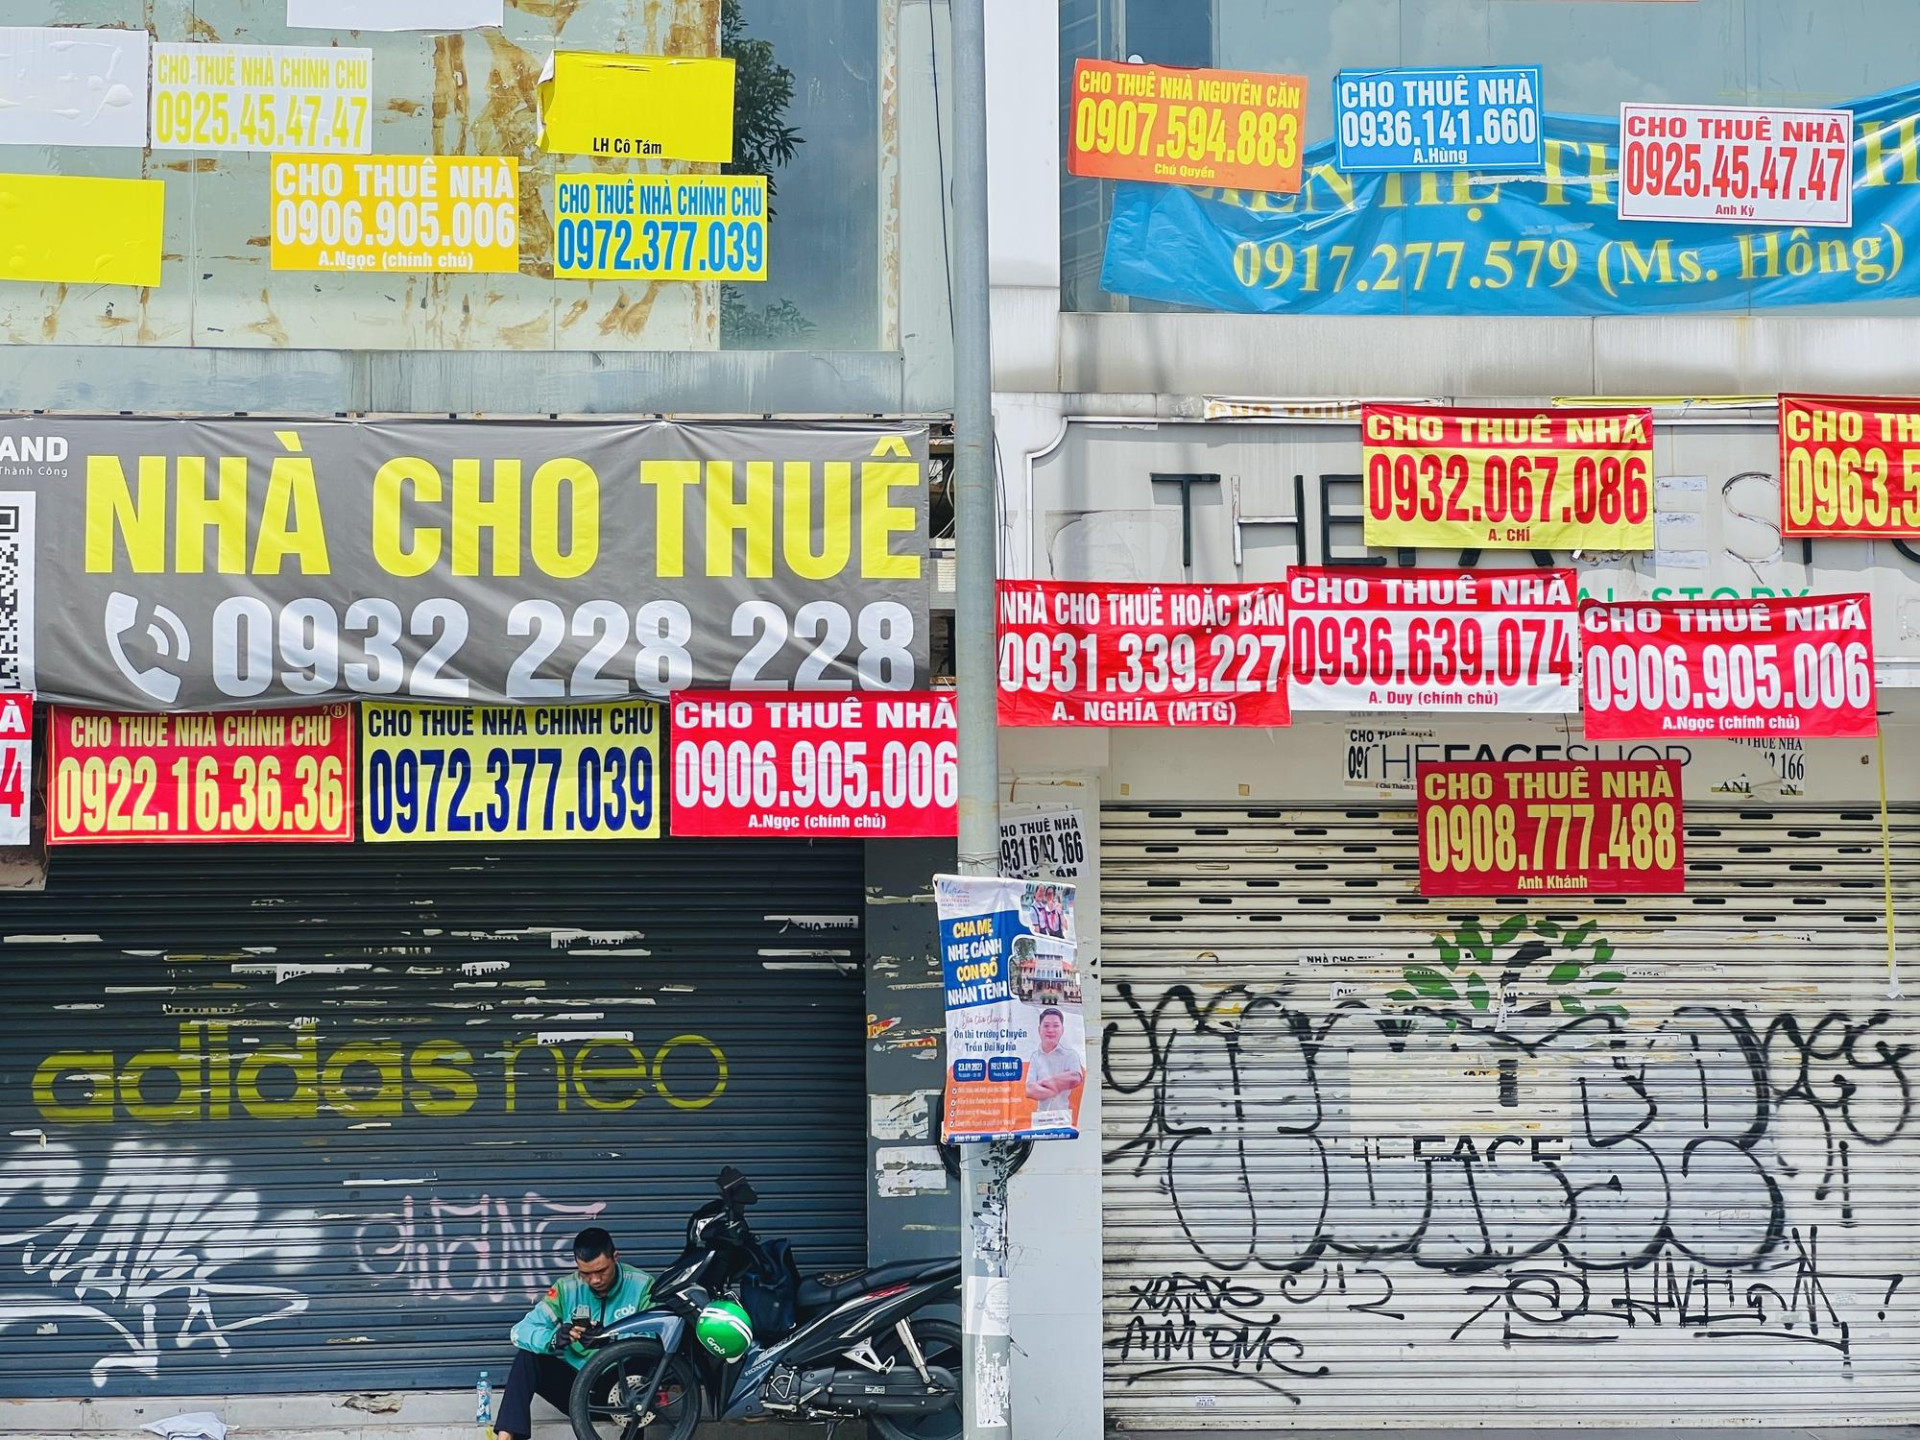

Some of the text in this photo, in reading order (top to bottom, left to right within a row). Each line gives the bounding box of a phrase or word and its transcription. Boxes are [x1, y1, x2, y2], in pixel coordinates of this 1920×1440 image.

[157, 54, 190, 84] CHO
[195, 52, 235, 86] THUÊ
[241, 51, 274, 87] NHÀ
[280, 51, 329, 89] CHÍNH
[1079, 69, 1300, 109] CHO THUÊ NHÀ NGUYÊN CĂN
[1342, 72, 1533, 109] CHO THUÊ NHÀ
[155, 91, 368, 147] 0925.45.47.47
[1075, 97, 1298, 170] 0907.594.883
[1342, 107, 1536, 149] 0936.141.660
[1627, 115, 1845, 144] CHO THUÊ NHÀ
[593, 137, 662, 155] LH Cô Tám
[1413, 147, 1468, 165] A.Hùng
[275, 158, 514, 199] CHO THUÊ NHÀ
[1155, 163, 1215, 180] Chú Quyền
[1627, 141, 1846, 202] 0925.45.47.47
[559, 179, 763, 217] CHO THUÊ NHÀ CHÍNH CHỦ
[1715, 204, 1738, 216] Anh
[276, 200, 515, 248] 0906.905.006
[318, 251, 474, 270] A.Ngọc (chính chủ)
[558, 219, 763, 272] 0972.377.039
[1233, 238, 1577, 293] 0917.277.579
[1597, 239, 1719, 298] (Ms.
[1367, 413, 1647, 445] CHO THUÊ NHÀ
[1787, 410, 1863, 442] CHO
[38, 466, 68, 478] Công
[1369, 453, 1647, 526] 0932.067.086
[85, 431, 921, 580] NHÀ CHO THUÊ
[1488, 526, 1530, 542] A. CHÍ
[1291, 576, 1369, 605] CHO
[1380, 573, 1477, 604] THUÊ
[1492, 572, 1571, 606] NHÀ
[1001, 585, 1284, 634] NHÀ CHO THUÊ HOẶC BÁN
[1583, 598, 1866, 633] CHO THUÊ NHÀ
[212, 596, 915, 698] 0932 228 228
[998, 632, 1286, 694] 0931.339.227
[1292, 616, 1572, 687] 0936.639.074
[1586, 640, 1869, 713] 0906.905.006
[675, 696, 957, 729] CHO THUÊ NHÀ
[1052, 697, 1237, 726] A. NGHĨA (MTG)
[1369, 690, 1499, 707] A. Duy (chính chủ)
[71, 704, 331, 748] CHO THUÊ NHÀ CHÍNH CHỦ
[368, 701, 653, 737] CHO THUÊ NHÀ CHÍNH CHỦ
[1350, 729, 1374, 742] CHO
[1662, 713, 1800, 733] A.Ngọc (chính chủ)
[369, 746, 654, 835] 0972.377.039
[675, 739, 958, 809] 0906.905.006
[1425, 763, 1674, 799] CHO THUÊ NHÀ
[57, 755, 344, 833] 0922.16.36.36
[748, 811, 887, 832] A.Ngọc (chính chủ)
[1020, 817, 1051, 834] THUÊ
[1054, 814, 1079, 831] NHÀ
[1425, 801, 1677, 873] 0908.777.488
[1058, 831, 1084, 865] 166
[1518, 874, 1588, 890] Anh Khánh
[953, 918, 993, 939] CHA MẸ
[947, 943, 970, 965] NHẸ
[947, 978, 1008, 1006] NHÀN TÊNH
[956, 965, 979, 983] CON
[32, 1021, 729, 1126] adidas neo
[744, 1359, 775, 1377] HONDA
